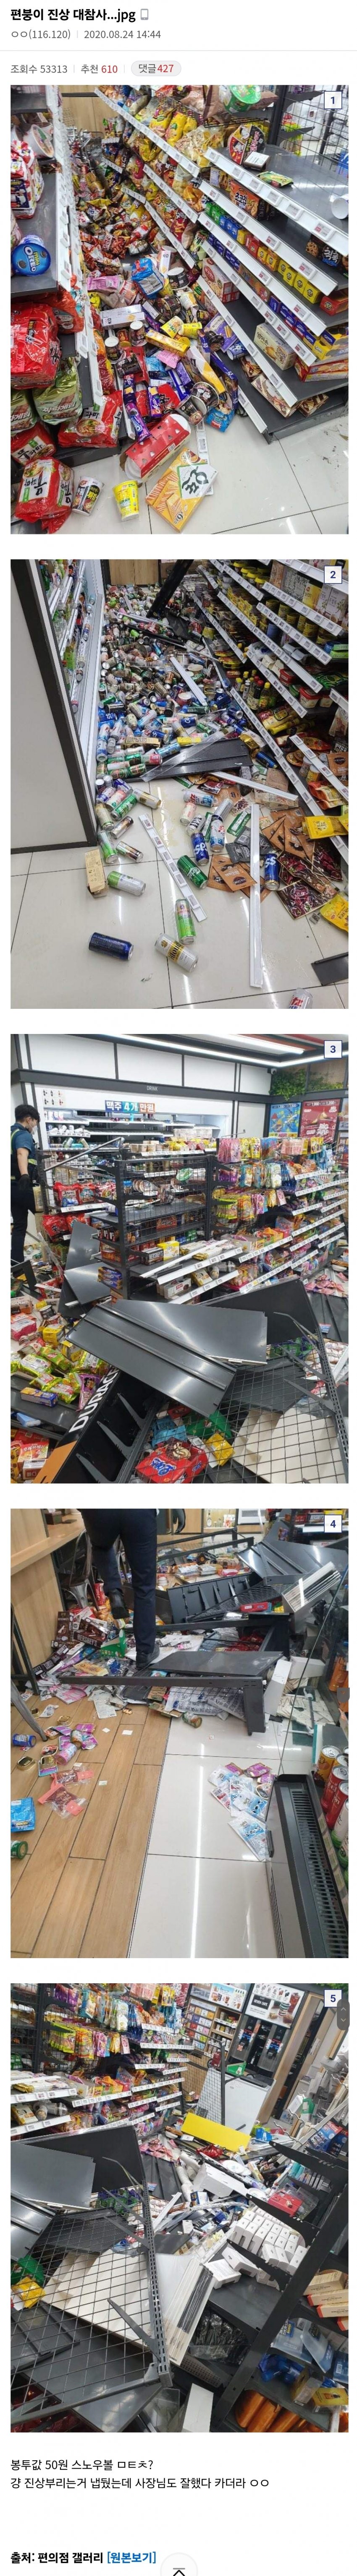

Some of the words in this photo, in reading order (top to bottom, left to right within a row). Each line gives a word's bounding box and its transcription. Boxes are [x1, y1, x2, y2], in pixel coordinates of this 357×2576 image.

[257, 332, 269, 346] 엄마손
[106, 1101, 122, 1111] 맥주
[140, 1103, 154, 1112] 만원
[149, 1250, 163, 1259] HERSHEY'S
[77, 1633, 98, 1647] HERSHEY'S
